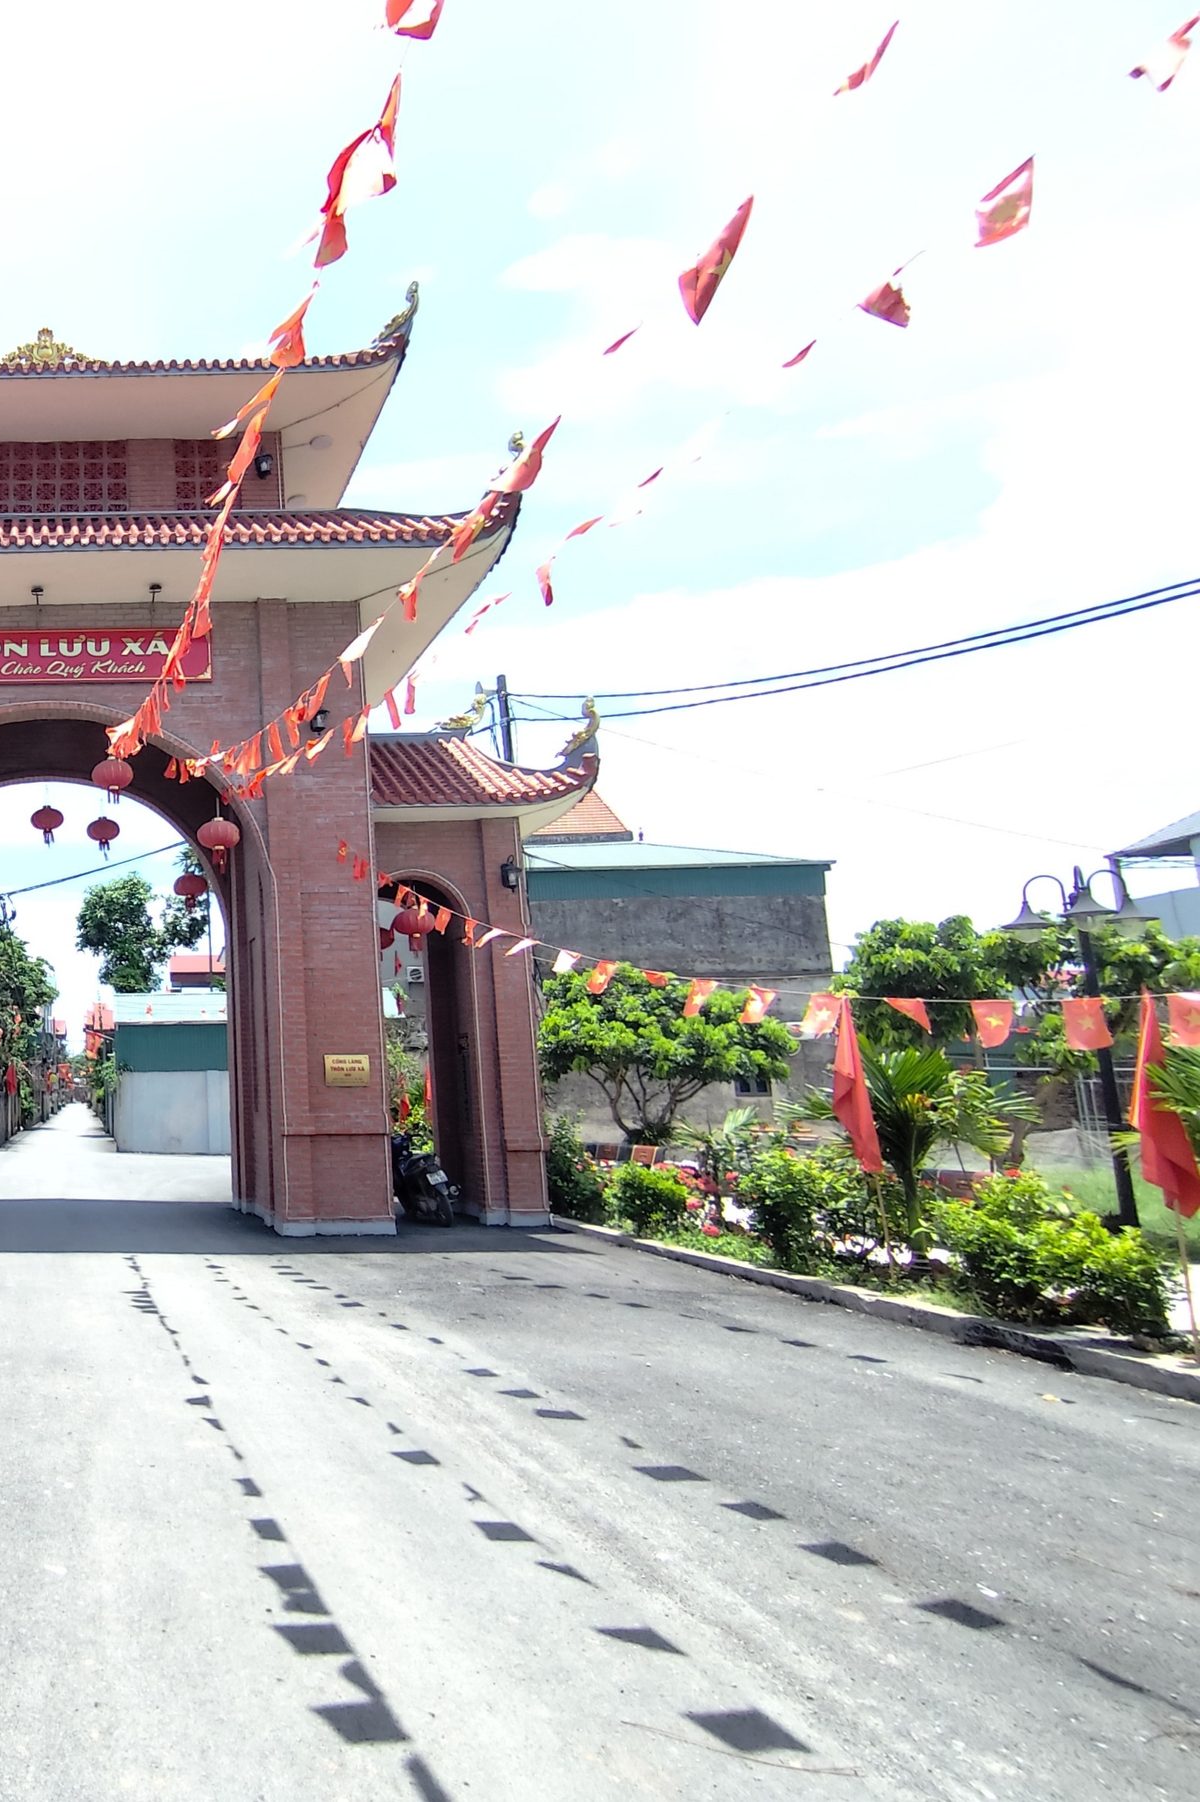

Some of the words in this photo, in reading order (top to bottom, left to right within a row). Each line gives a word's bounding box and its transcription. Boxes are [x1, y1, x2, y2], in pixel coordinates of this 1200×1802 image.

[40, 634, 110, 657] LƯU
[120, 631, 171, 656] XÁ
[0, 660, 42, 676] Chào
[46, 660, 86, 678] Quý
[90, 659, 146, 674] Khách
